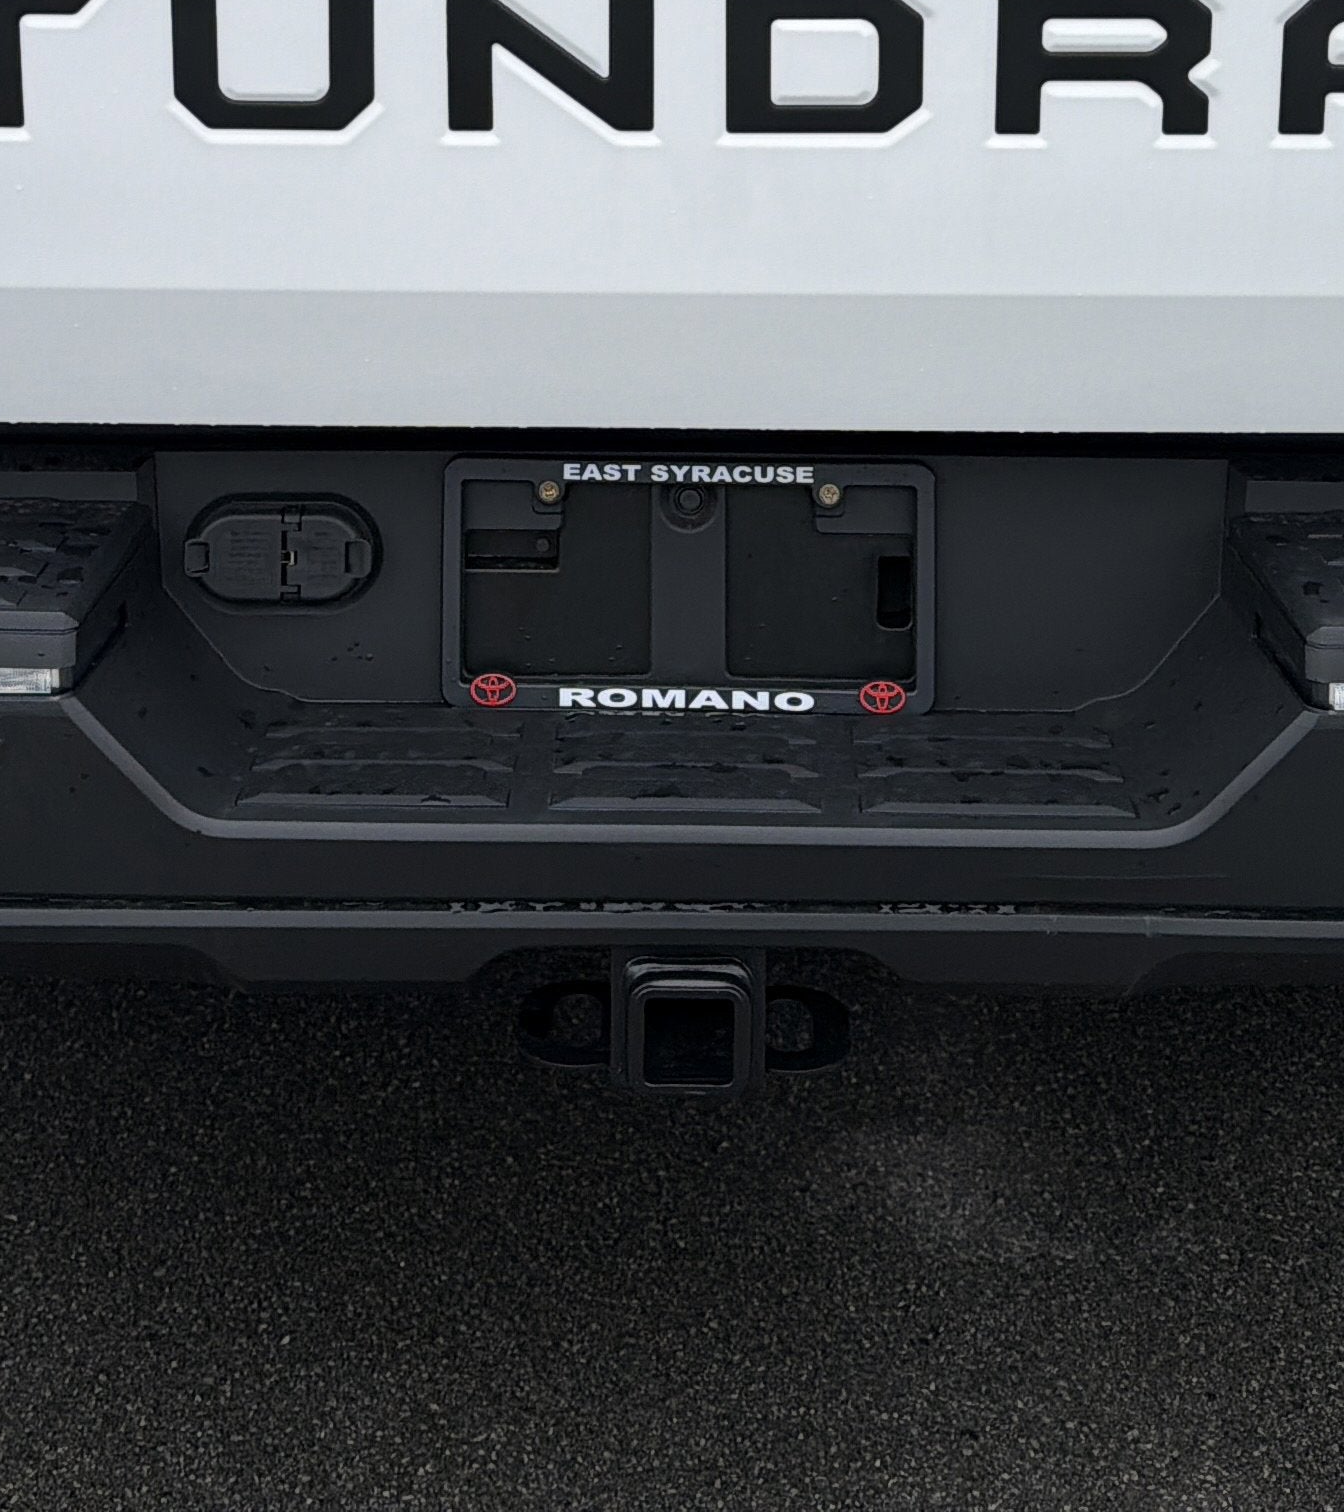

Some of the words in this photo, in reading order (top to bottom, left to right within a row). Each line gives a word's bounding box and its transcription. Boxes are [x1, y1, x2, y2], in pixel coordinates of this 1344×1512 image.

[562, 463, 642, 483] EAST
[649, 464, 815, 484] SYRACUSE
[558, 686, 816, 713] ROMANO
